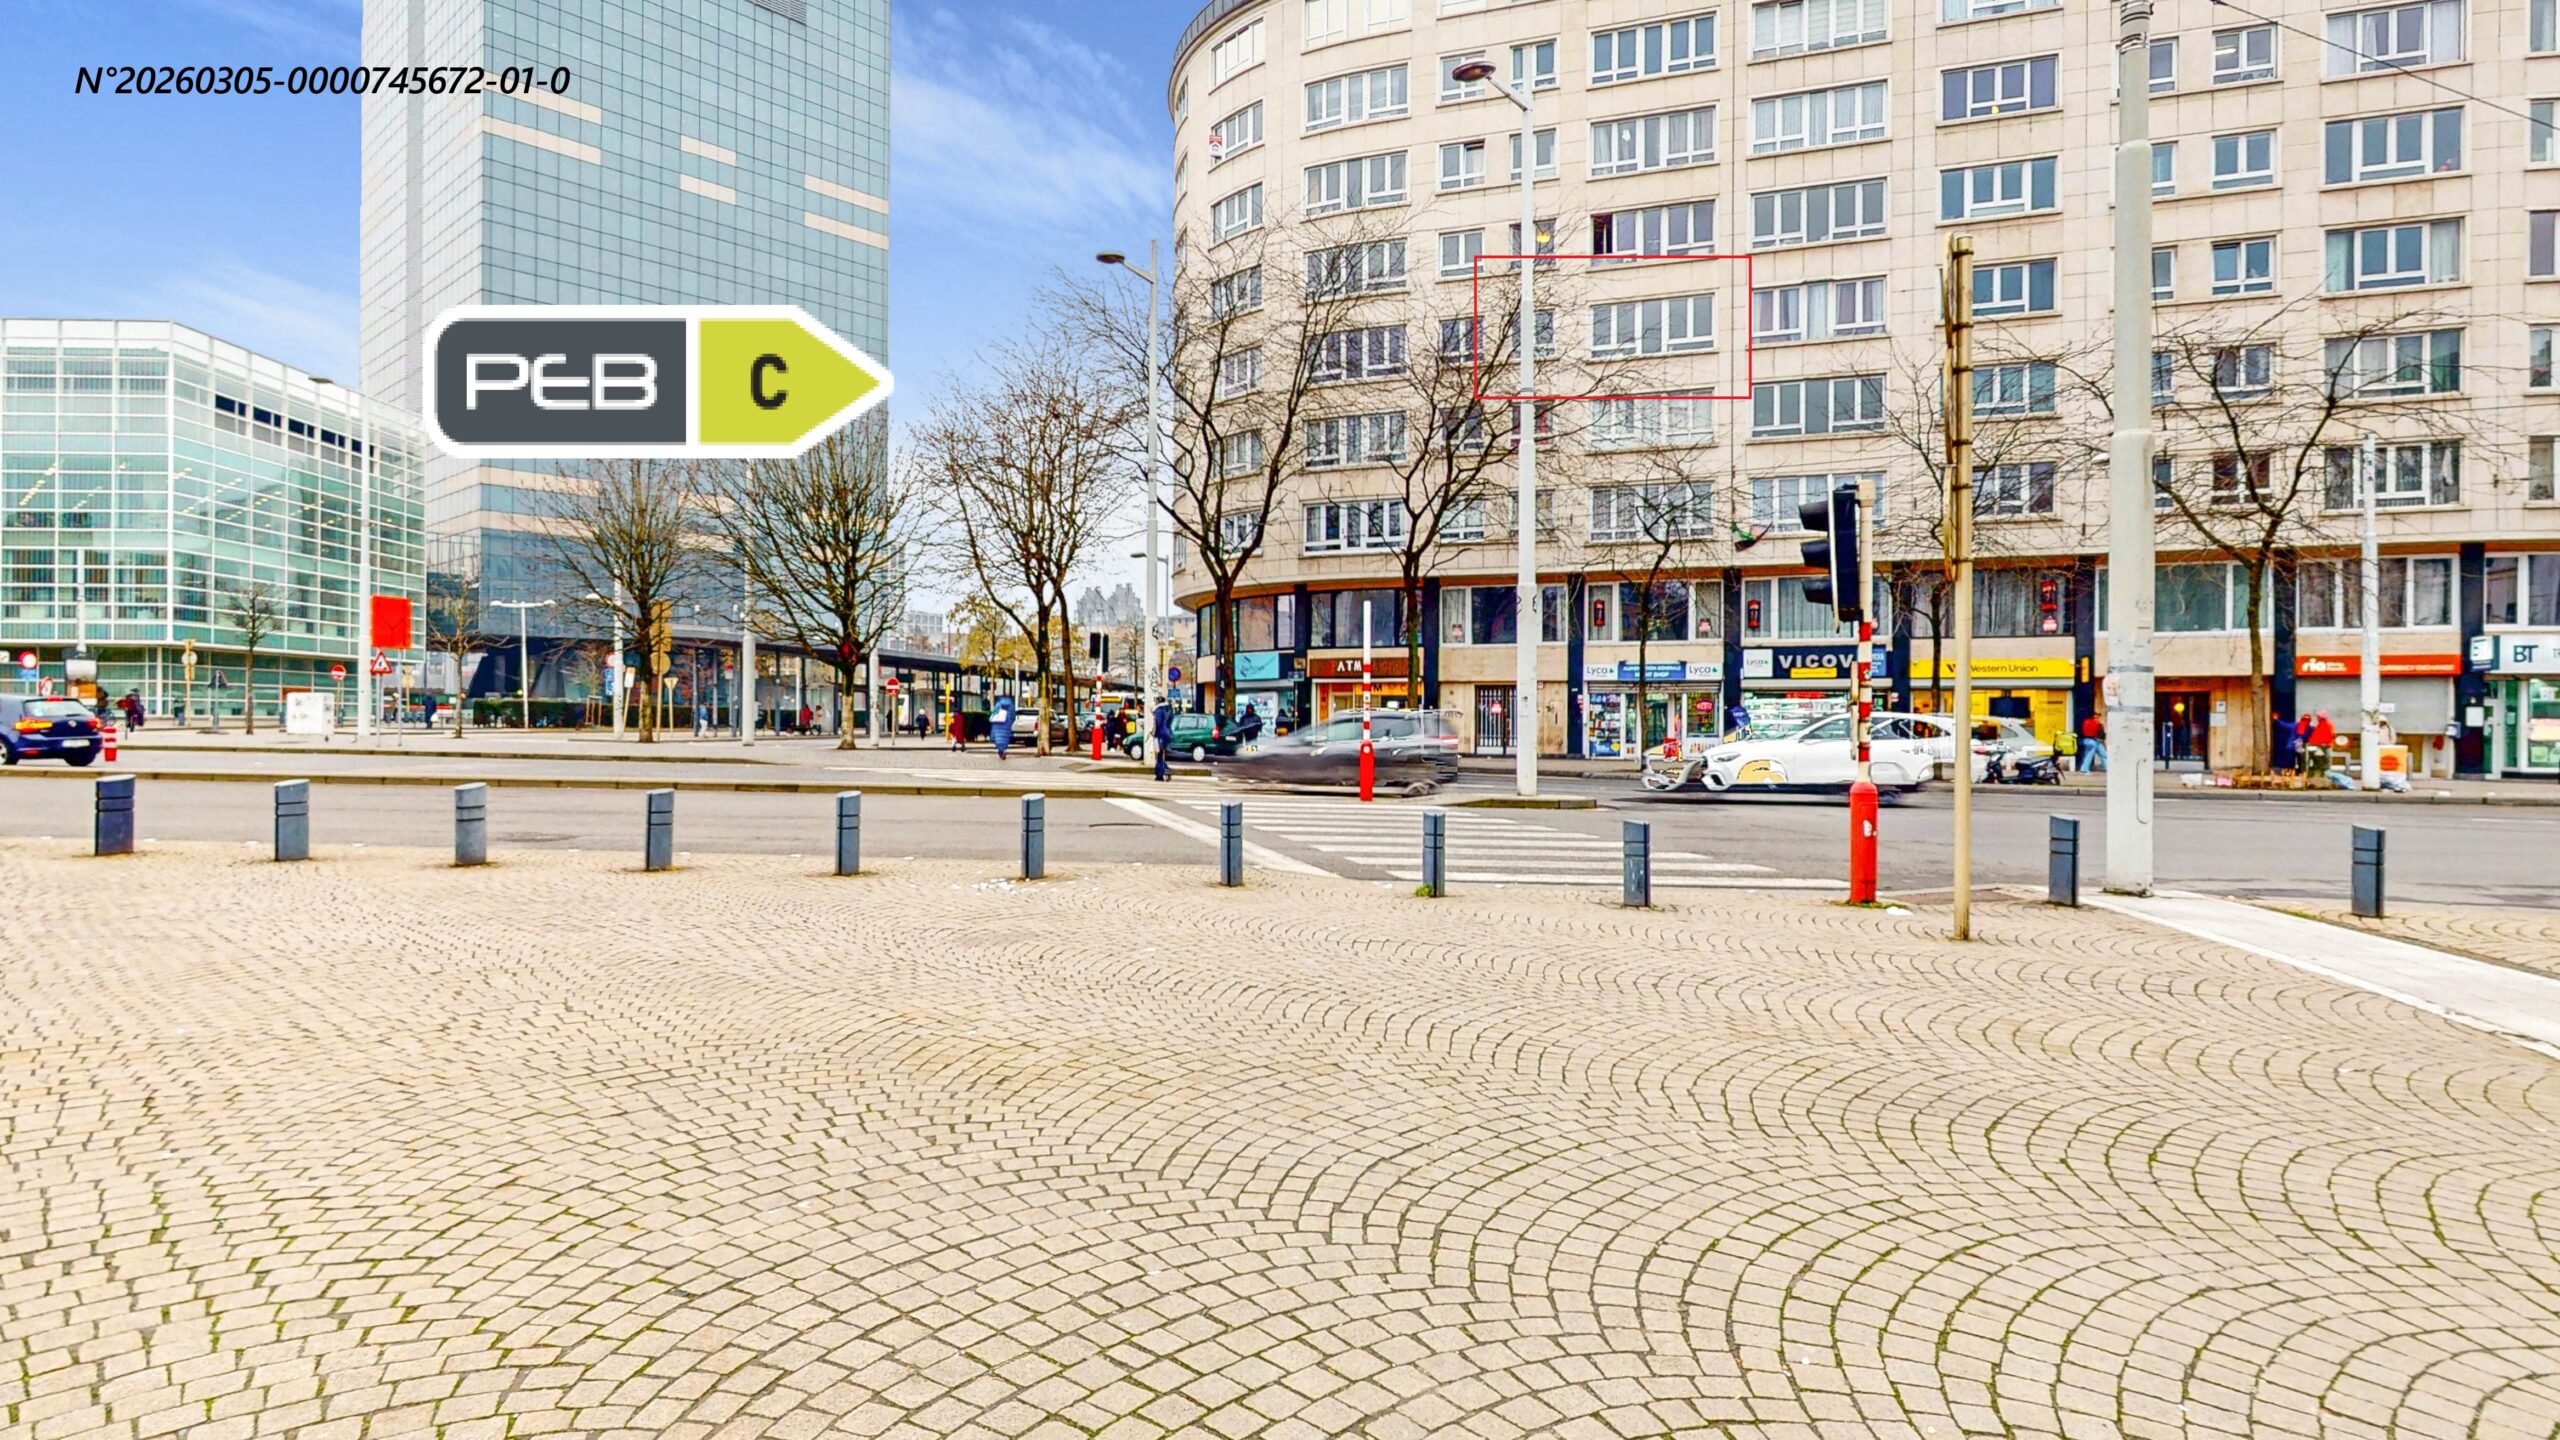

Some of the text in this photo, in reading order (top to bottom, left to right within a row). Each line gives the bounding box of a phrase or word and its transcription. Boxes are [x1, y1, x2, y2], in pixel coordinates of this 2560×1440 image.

[2513, 645, 2539, 663] BT
[1337, 660, 1362, 672] ATM
[1586, 666, 1608, 675] Lyca
[1688, 665, 1711, 674] Lyca
[2008, 664, 2038, 673] Union
